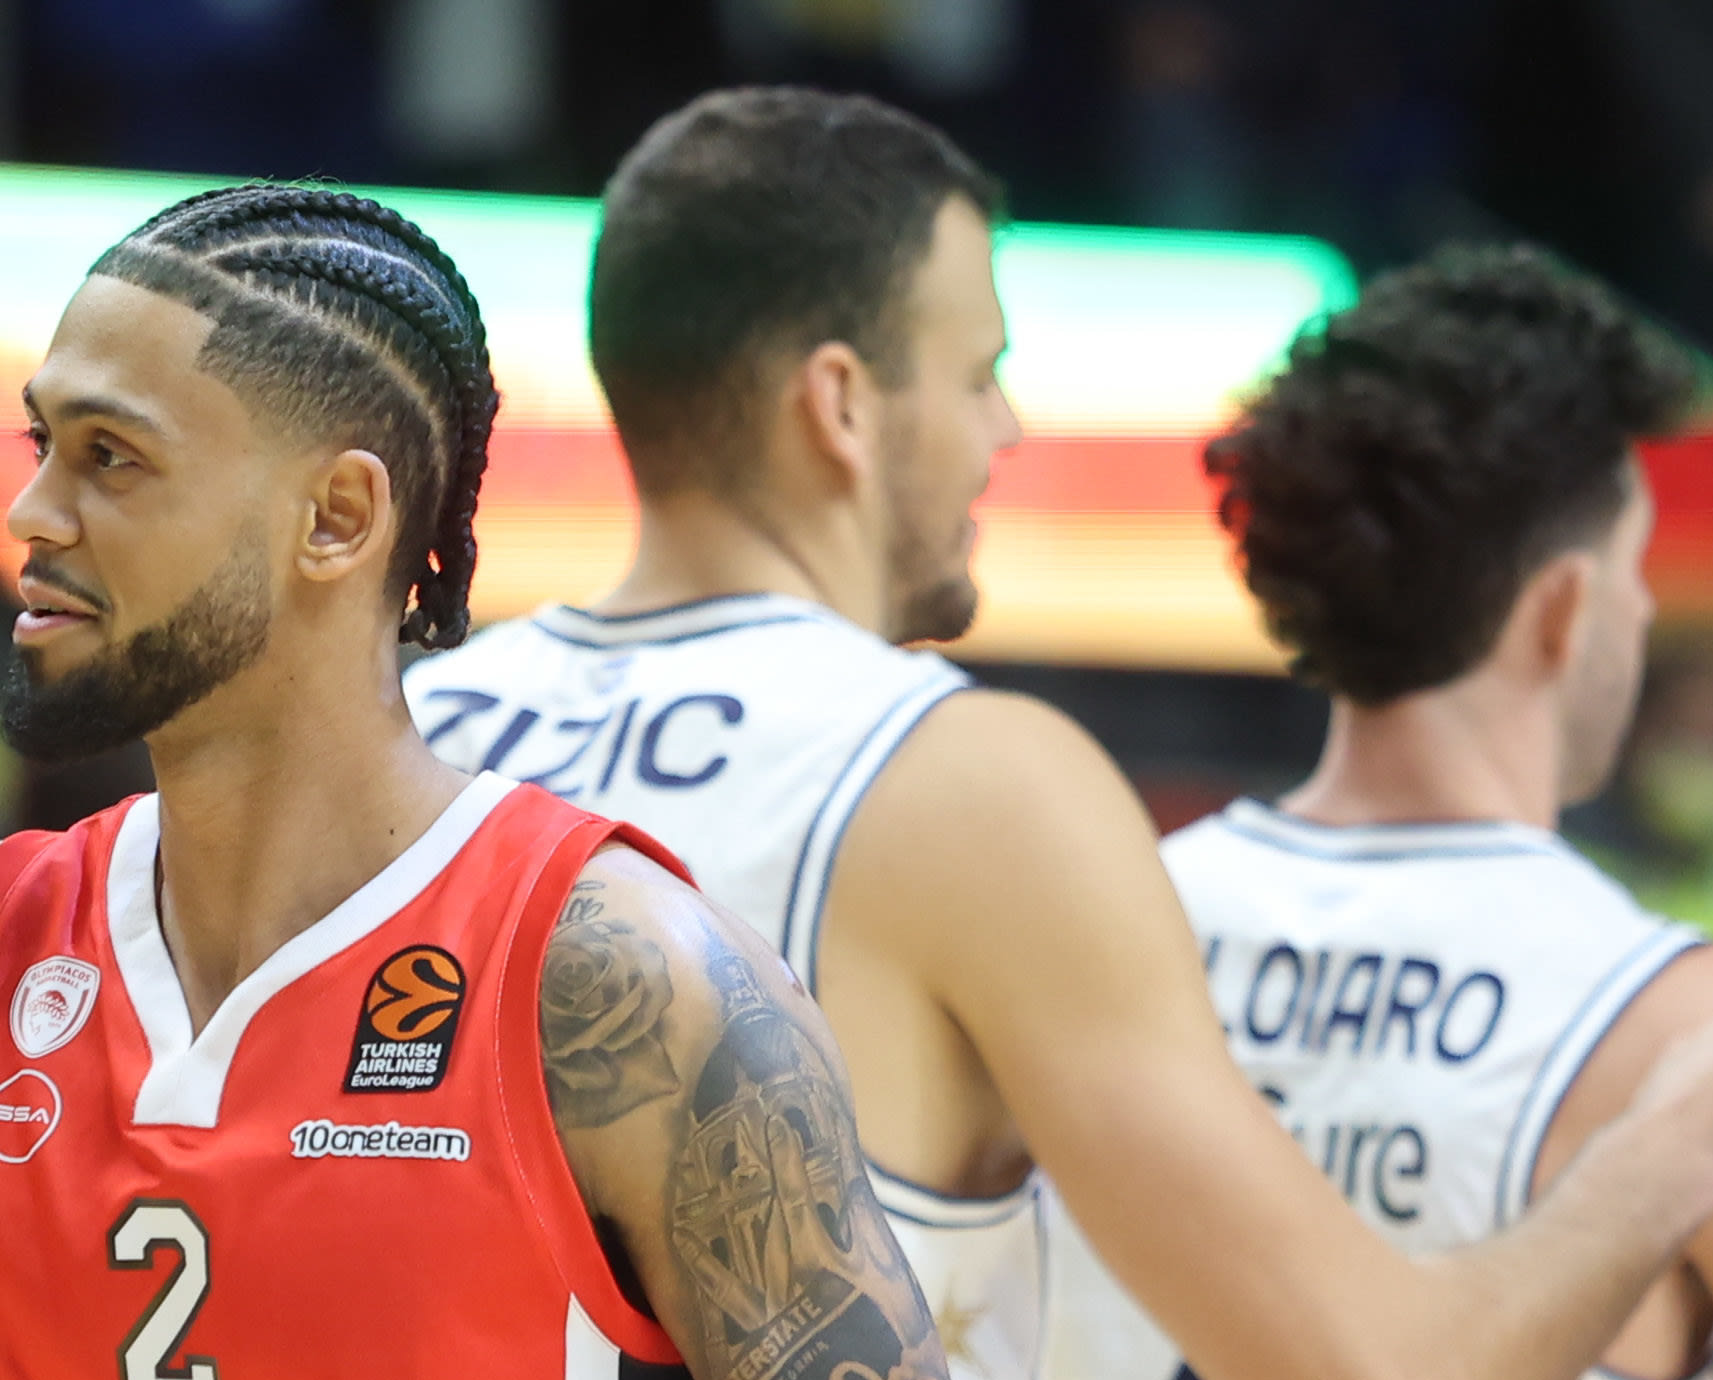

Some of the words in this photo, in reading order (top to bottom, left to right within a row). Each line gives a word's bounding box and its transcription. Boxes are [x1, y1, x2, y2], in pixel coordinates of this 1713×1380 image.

[360, 1043, 443, 1058] TURKISH
[354, 1058, 439, 1074] AIRLINES
[351, 1073, 435, 1089] EuroLeague
